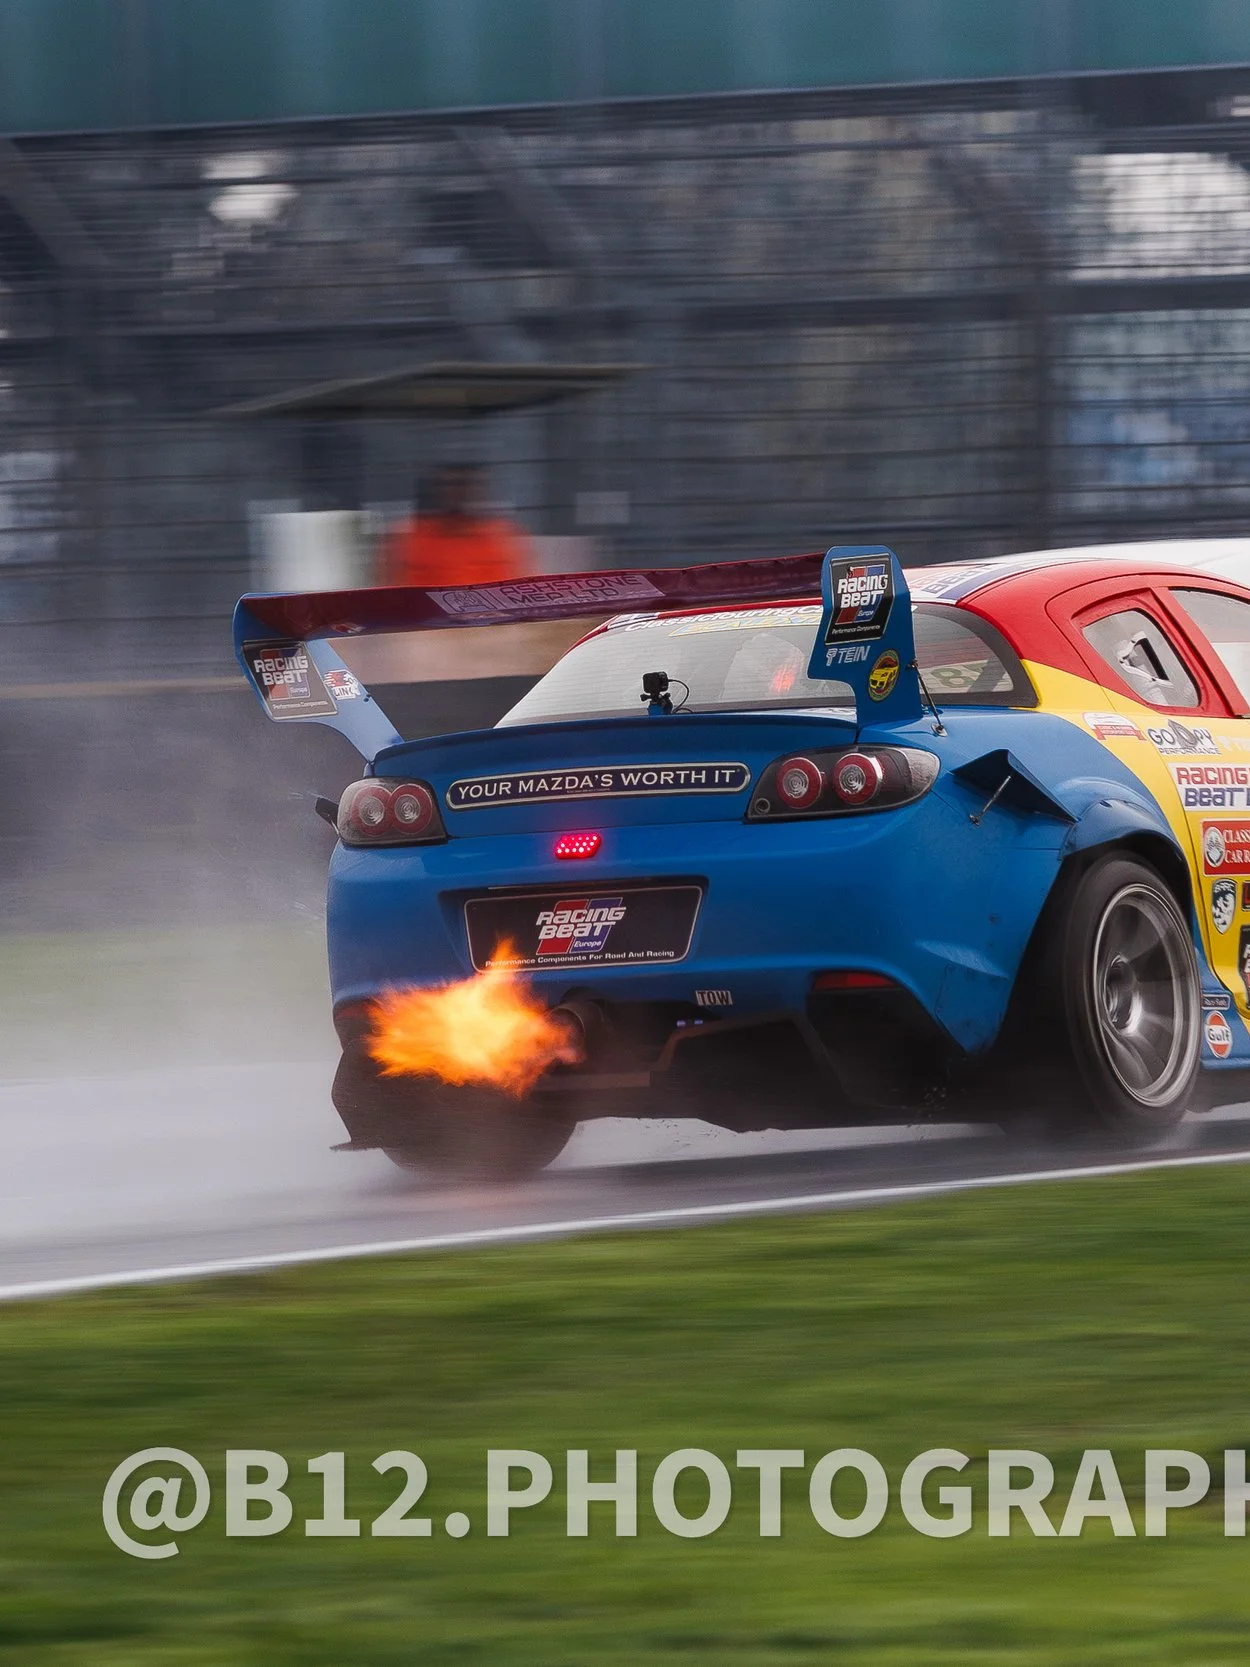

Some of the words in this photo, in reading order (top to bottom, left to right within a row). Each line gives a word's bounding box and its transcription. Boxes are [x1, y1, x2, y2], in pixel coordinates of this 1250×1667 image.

[500, 575, 642, 596] ASHSTONE
[1158, 747, 1222, 755] PERFORMANCE
[458, 781, 513, 800] YOUR
[518, 774, 614, 795] MAZDA'S
[621, 769, 707, 787] WORTH
[713, 769, 737, 784] IT
[1224, 849, 1243, 863] CAR
[573, 938, 602, 949] Europe
[537, 954, 587, 965] Components
[589, 952, 602, 961] For
[605, 952, 626, 960] Road
[628, 951, 644, 959] And
[646, 949, 675, 959] Racing
[697, 991, 730, 1006] TOW
[1208, 1027, 1230, 1041] Gulf
